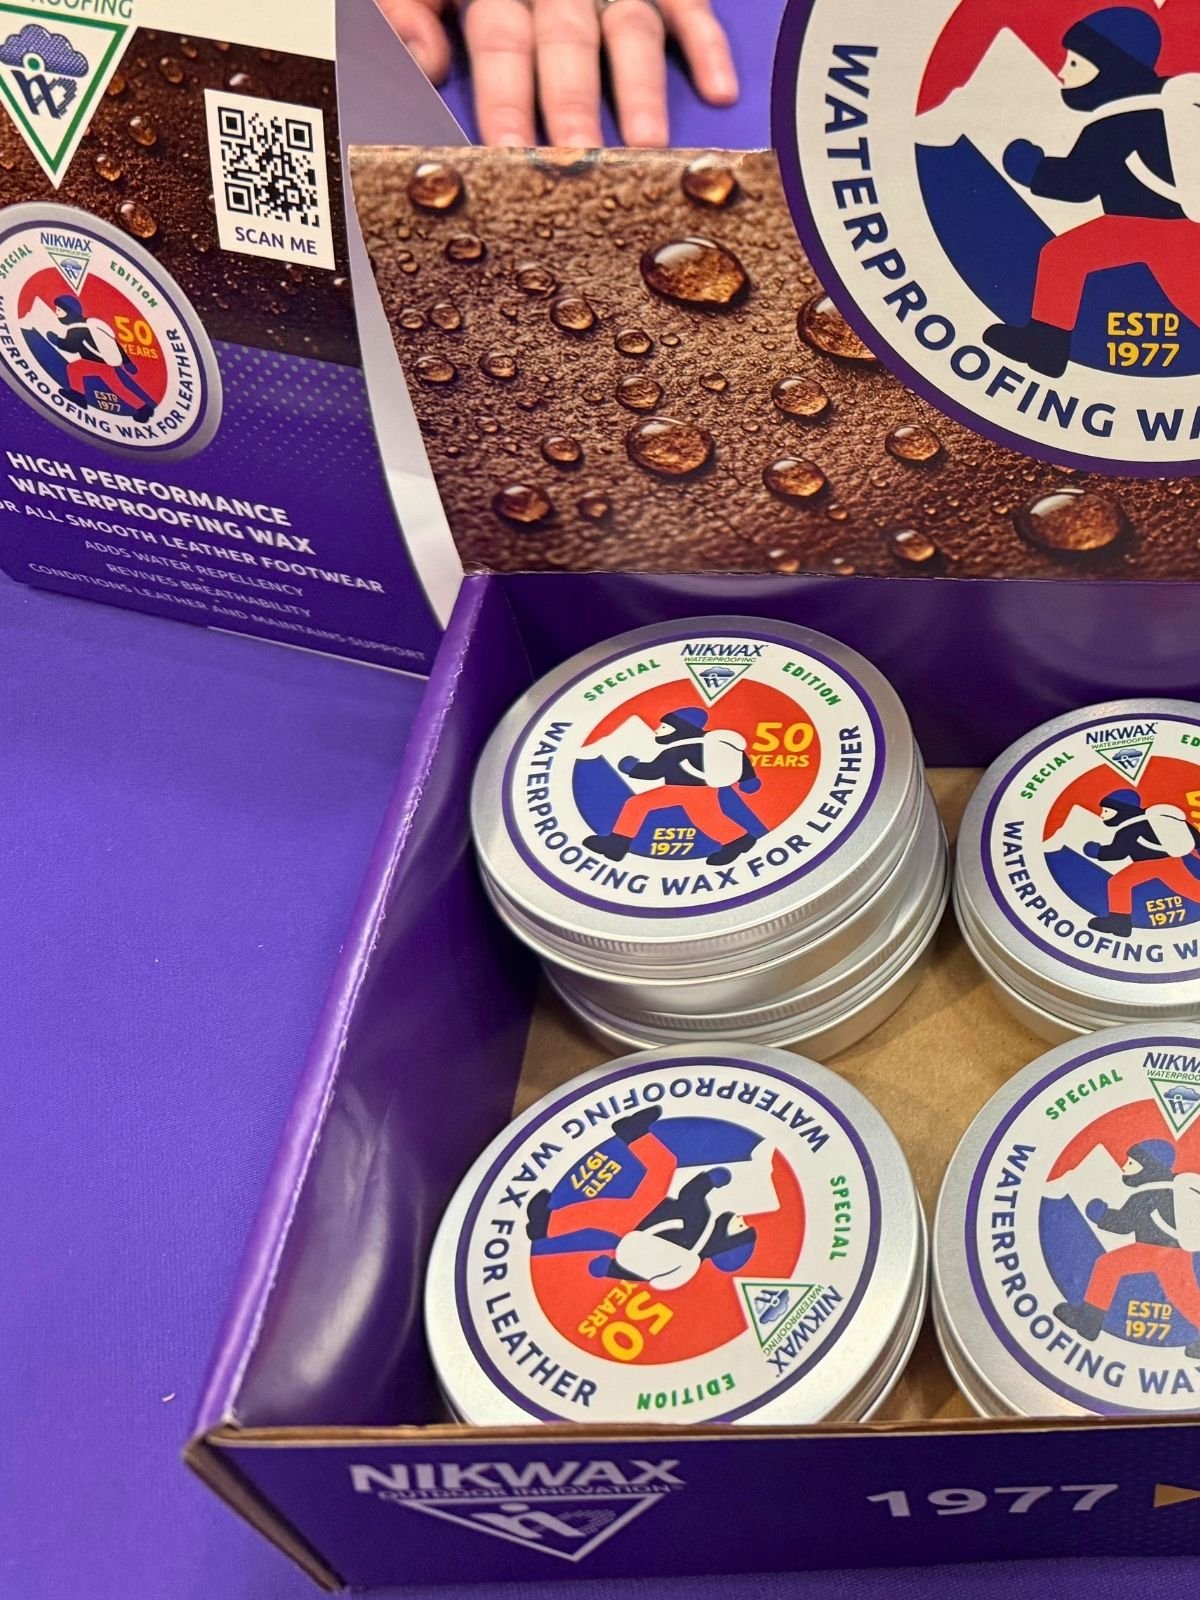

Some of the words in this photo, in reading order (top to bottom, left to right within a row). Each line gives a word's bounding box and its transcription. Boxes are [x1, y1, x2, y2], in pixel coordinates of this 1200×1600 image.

[40, 232, 92, 252] NIKWAX
[235, 226, 284, 249] SCAN
[290, 238, 318, 256] ME
[824, 44, 1115, 438] WATERPROOFING
[0, 244, 32, 279] SPECIAL
[110, 261, 159, 308] EDITION
[114, 315, 153, 345] 50
[1107, 313, 1179, 337] ESTD
[121, 343, 158, 359] YEARS
[166, 328, 193, 411] LEATHER
[1106, 341, 1179, 367] 1977
[94, 390, 118, 402] ESTD
[97, 400, 121, 412] 1977
[116, 424, 157, 440] WAX
[157, 409, 186, 434] FOR
[6, 451, 77, 481] HIGH
[80, 467, 292, 526] PERFORMANCE
[8, 474, 244, 539] WATERPROOFING
[247, 526, 317, 555] WAX
[25, 505, 64, 523] ALL
[65, 514, 157, 543] SMOOTH
[161, 534, 258, 565] LEATHER
[261, 556, 386, 593] FOOTWEAR
[85, 540, 131, 558] ADDS
[132, 551, 192, 572] WATER
[196, 565, 303, 597] REPELLENCY
[105, 563, 178, 587] REVIVES
[180, 580, 312, 617] BREATHABILITY
[28, 562, 132, 593] CONDITIONS
[133, 586, 208, 610] LEATHER
[213, 605, 248, 619] AND
[251, 613, 346, 643] MAINTAINS
[347, 636, 426, 660] SUPPORT
[681, 643, 766, 658] NIKWAX
[583, 659, 661, 702] SPECIAL
[782, 661, 841, 707] EDITION
[753, 722, 814, 752] 50
[1086, 723, 1157, 744] NIKWAX
[1091, 735, 1155, 750] WATERPROOFING
[749, 754, 810, 768] YEARS
[1020, 751, 1074, 800] SPECIAL
[526, 720, 651, 895] WATERPROOFING
[661, 868, 738, 896] WAX
[746, 836, 811, 877] FOR
[808, 725, 862, 832] LEATHER
[650, 842, 694, 856] 1977
[653, 827, 696, 840] ESTD
[1002, 820, 1164, 963] WATERPROOFING
[1145, 897, 1182, 913] ESTD
[1149, 909, 1186, 926] 1977
[1045, 1069, 1123, 1120] SPECIAL
[561, 1077, 830, 1154] WATERPROOFING
[498, 1141, 564, 1209] WAX
[571, 1150, 609, 1189] 1977
[581, 1160, 622, 1198] ESTD
[830, 1175, 852, 1261] SPECIAL
[483, 1219, 515, 1285] FOR
[991, 1142, 1124, 1388] WATERPROOFING
[578, 1279, 638, 1339] YEARS
[601, 1288, 674, 1361] 50
[763, 1284, 824, 1357] WATERPROOFING
[1127, 1300, 1172, 1319] ESTD
[486, 1290, 598, 1407] LEATHER
[766, 1285, 843, 1376] NIKWAX
[1125, 1320, 1172, 1340] 1977
[636, 1373, 736, 1410] EDITION
[350, 1460, 684, 1492] NIKWAX
[377, 1487, 509, 1500] OUTDOOR
[514, 1483, 671, 1496] INNOVATION
[866, 1483, 1119, 1518] 1977
